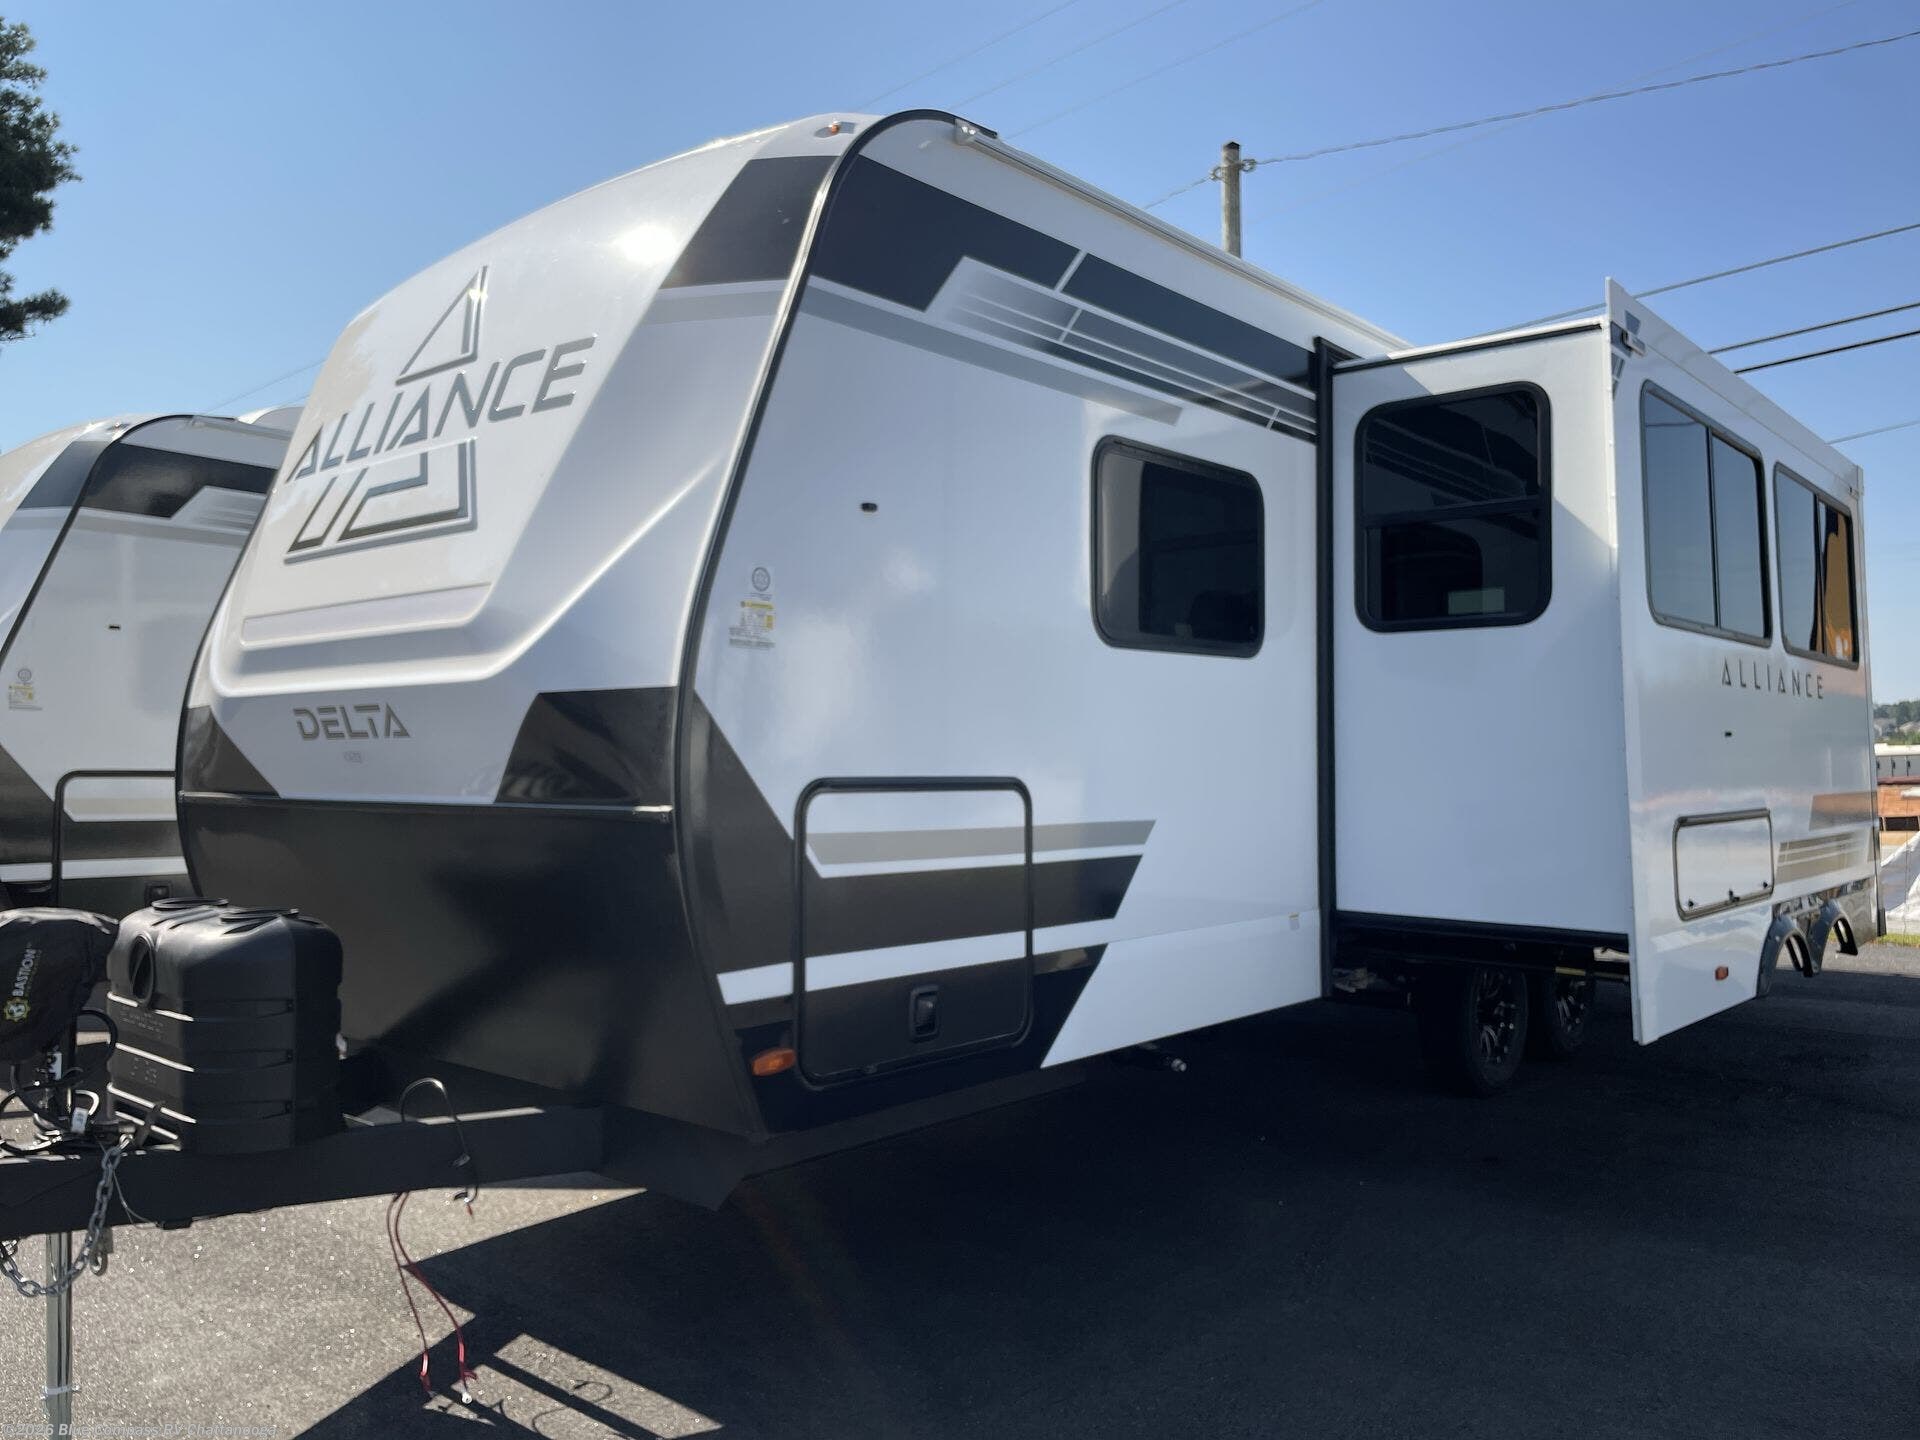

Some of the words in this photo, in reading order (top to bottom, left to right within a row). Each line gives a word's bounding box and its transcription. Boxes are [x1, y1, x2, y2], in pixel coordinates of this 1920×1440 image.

[285, 333, 597, 484] ALLIANCE
[1721, 656, 1824, 700] ALLIANCE
[292, 702, 411, 741] DELTA
